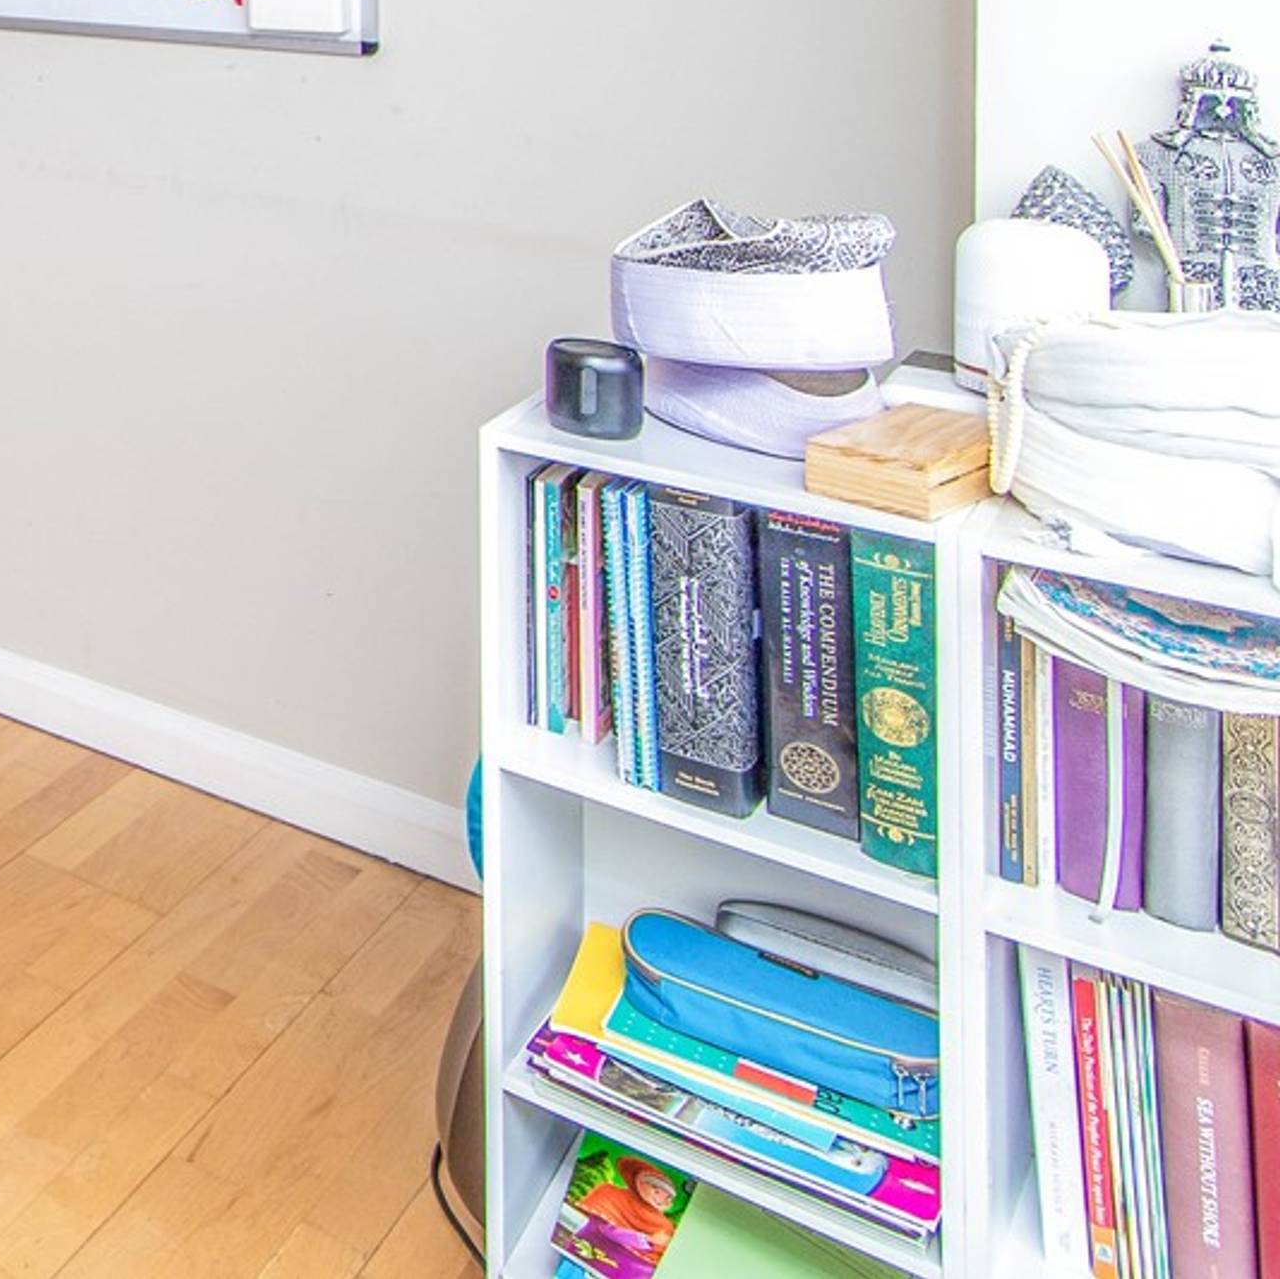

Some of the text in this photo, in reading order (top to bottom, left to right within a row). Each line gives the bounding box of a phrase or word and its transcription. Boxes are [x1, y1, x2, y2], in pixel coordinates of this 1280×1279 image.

[795, 575, 815, 642] Knowledge
[802, 643, 817, 667] and
[818, 563, 840, 727] THE COMPENDIUM
[802, 669, 818, 717] Wisdom
[1001, 669, 1016, 762] MUHAMMAD
[1042, 1030, 1060, 1075] TURN
[1196, 1096, 1220, 1249] SEA WITHOUT SHORE
